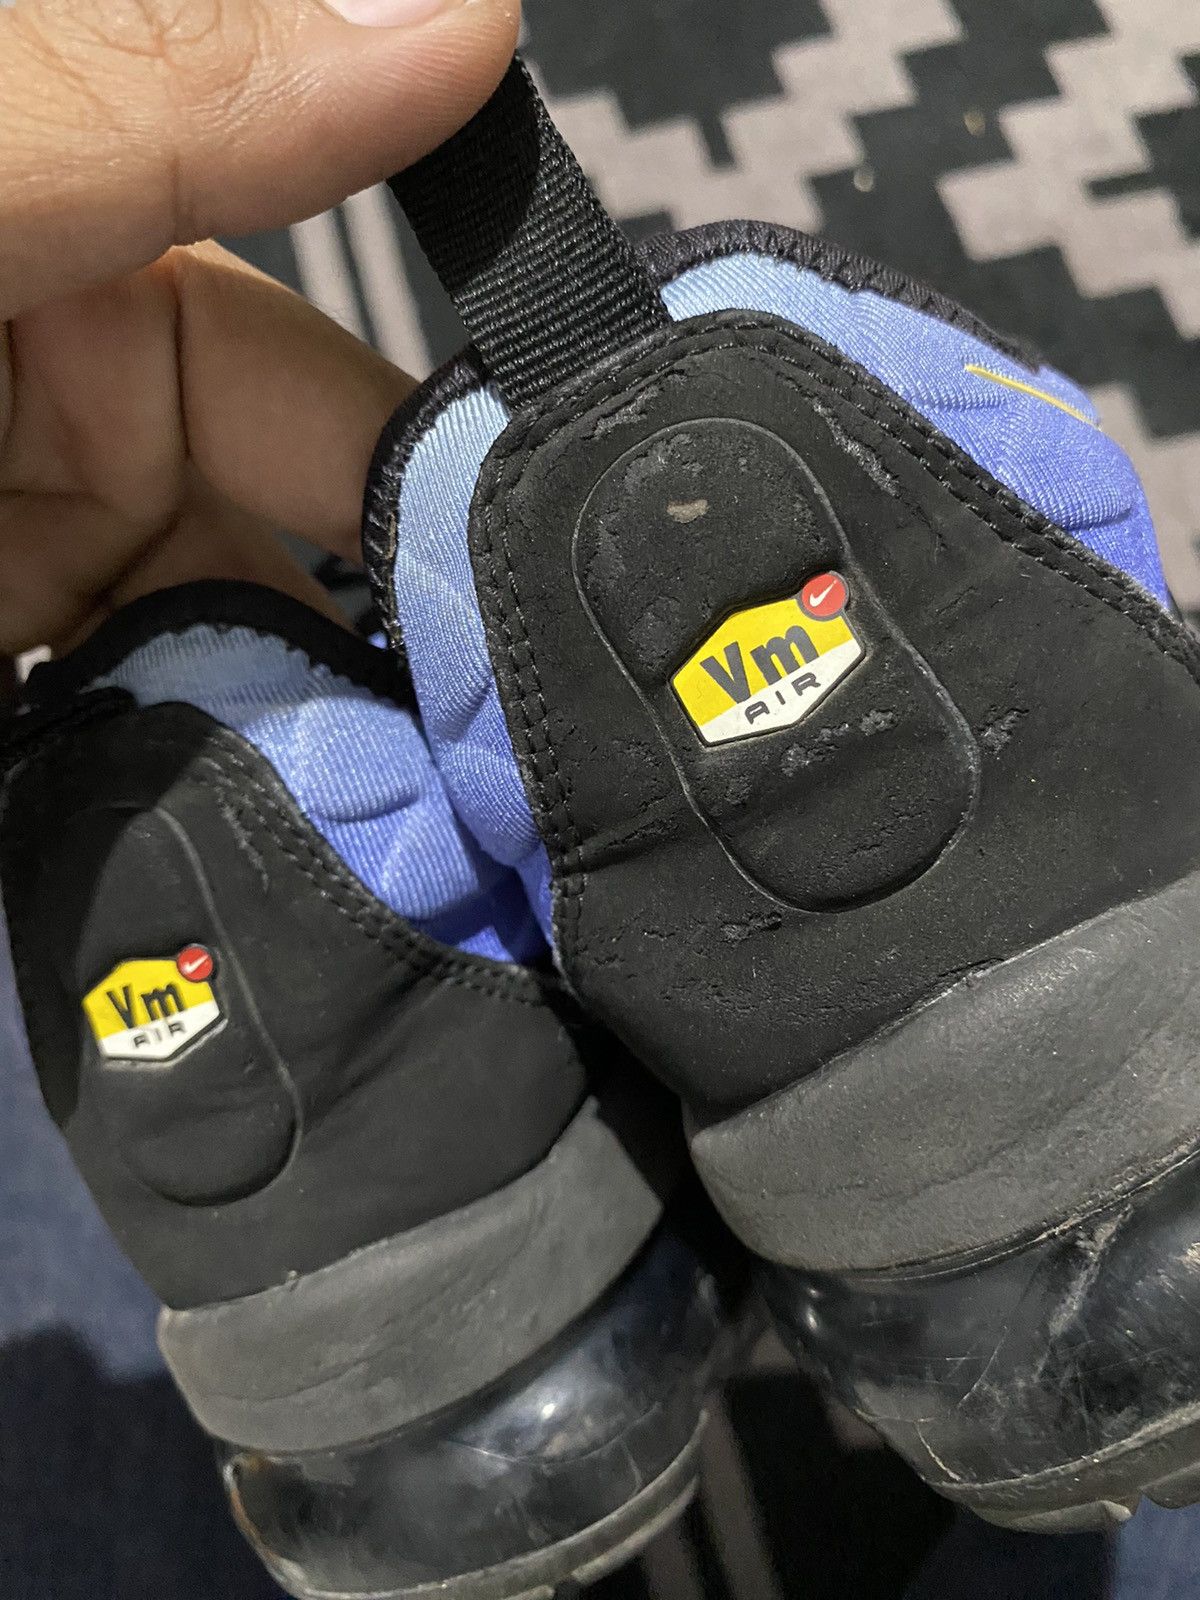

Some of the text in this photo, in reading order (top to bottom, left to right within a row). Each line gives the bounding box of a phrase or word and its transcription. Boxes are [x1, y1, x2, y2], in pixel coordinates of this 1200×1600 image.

[700, 625, 820, 704] Vm
[744, 672, 821, 724] AIR
[106, 979, 187, 1029] Vm
[133, 1021, 187, 1048] AIR
